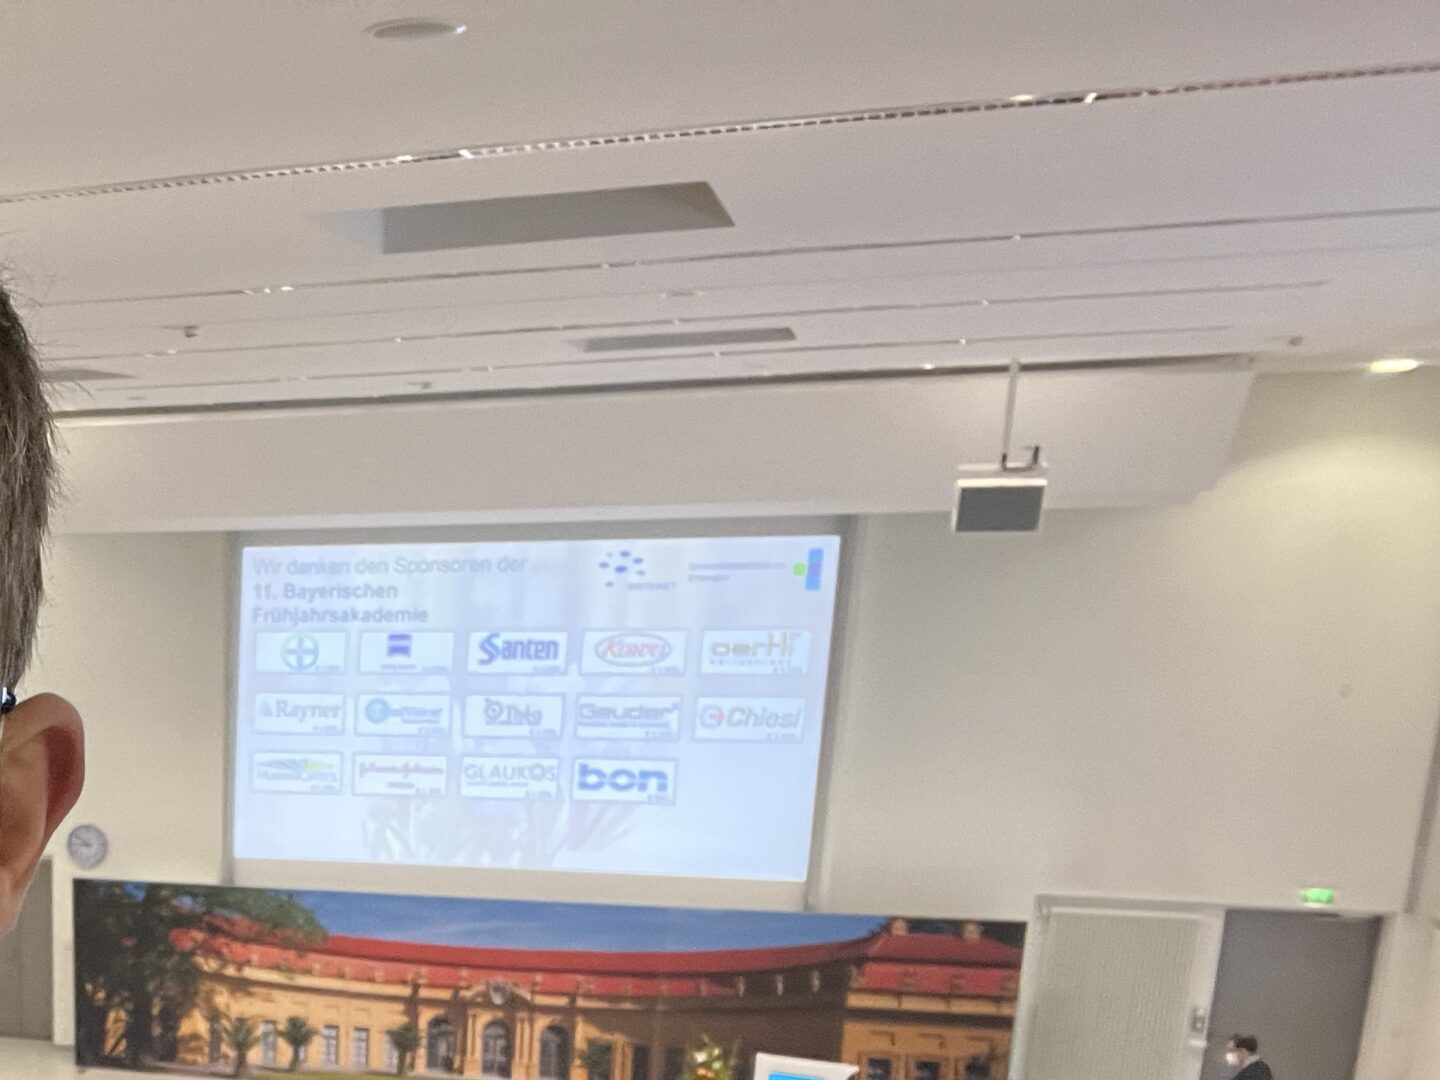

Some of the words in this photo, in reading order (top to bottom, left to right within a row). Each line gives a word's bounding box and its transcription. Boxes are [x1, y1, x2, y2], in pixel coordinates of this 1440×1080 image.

[355, 559, 388, 575] den
[393, 557, 492, 578] Sponsoren
[497, 556, 527, 573] der
[283, 583, 398, 603] Bayerischen
[252, 607, 429, 627] Frühjahrsakademie
[478, 632, 559, 665] Santen
[275, 700, 342, 723] Rayner
[464, 763, 557, 781] GLAUKOS
[577, 763, 668, 792] bon
